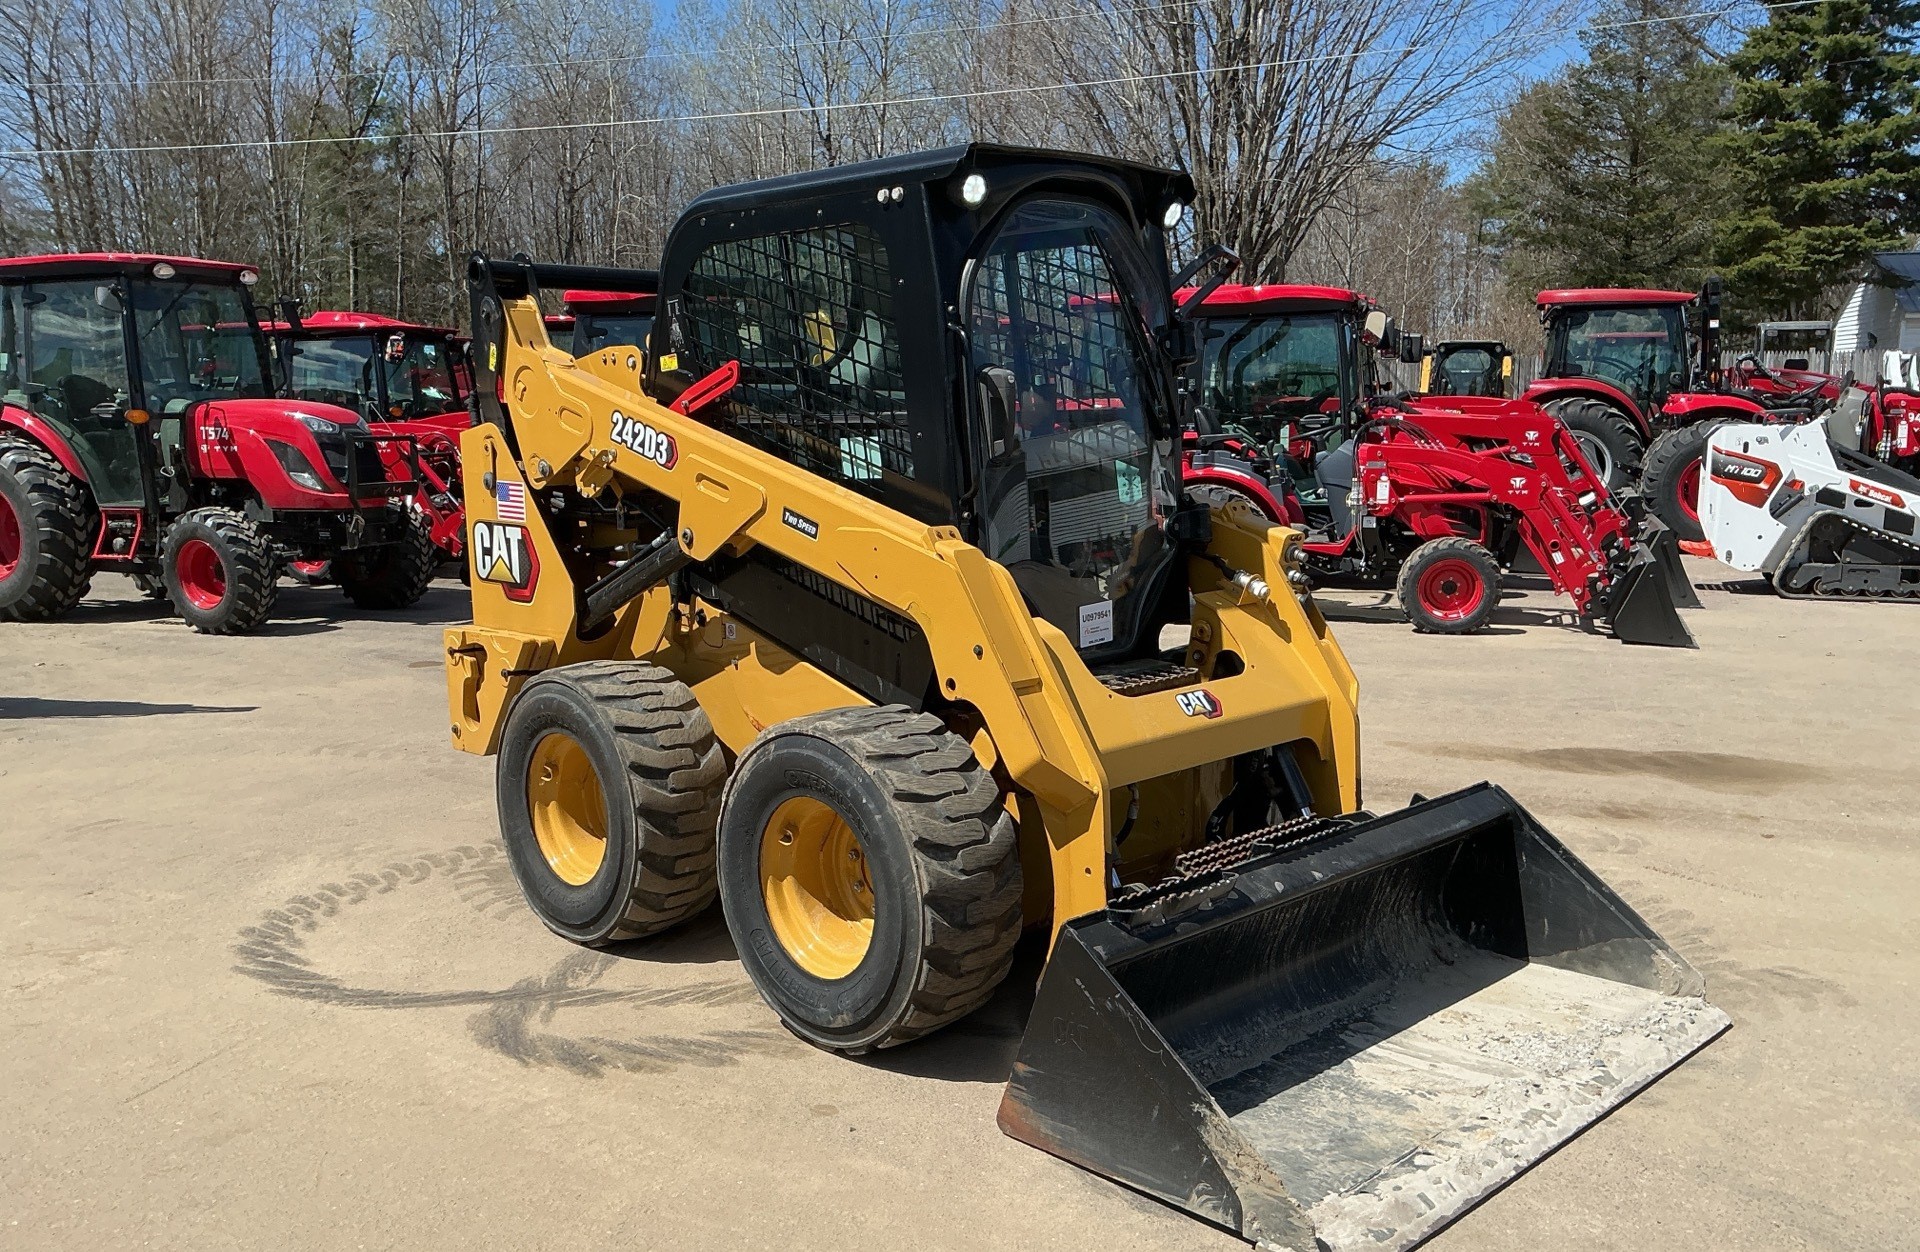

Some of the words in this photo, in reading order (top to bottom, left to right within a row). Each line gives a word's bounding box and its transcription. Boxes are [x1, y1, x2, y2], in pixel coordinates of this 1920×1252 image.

[200, 426, 229, 440] T574
[609, 411, 668, 466] 242D3
[1868, 489, 1893, 502] Bobcat
[474, 522, 523, 584] CAT
[1174, 690, 1213, 717] CAT
